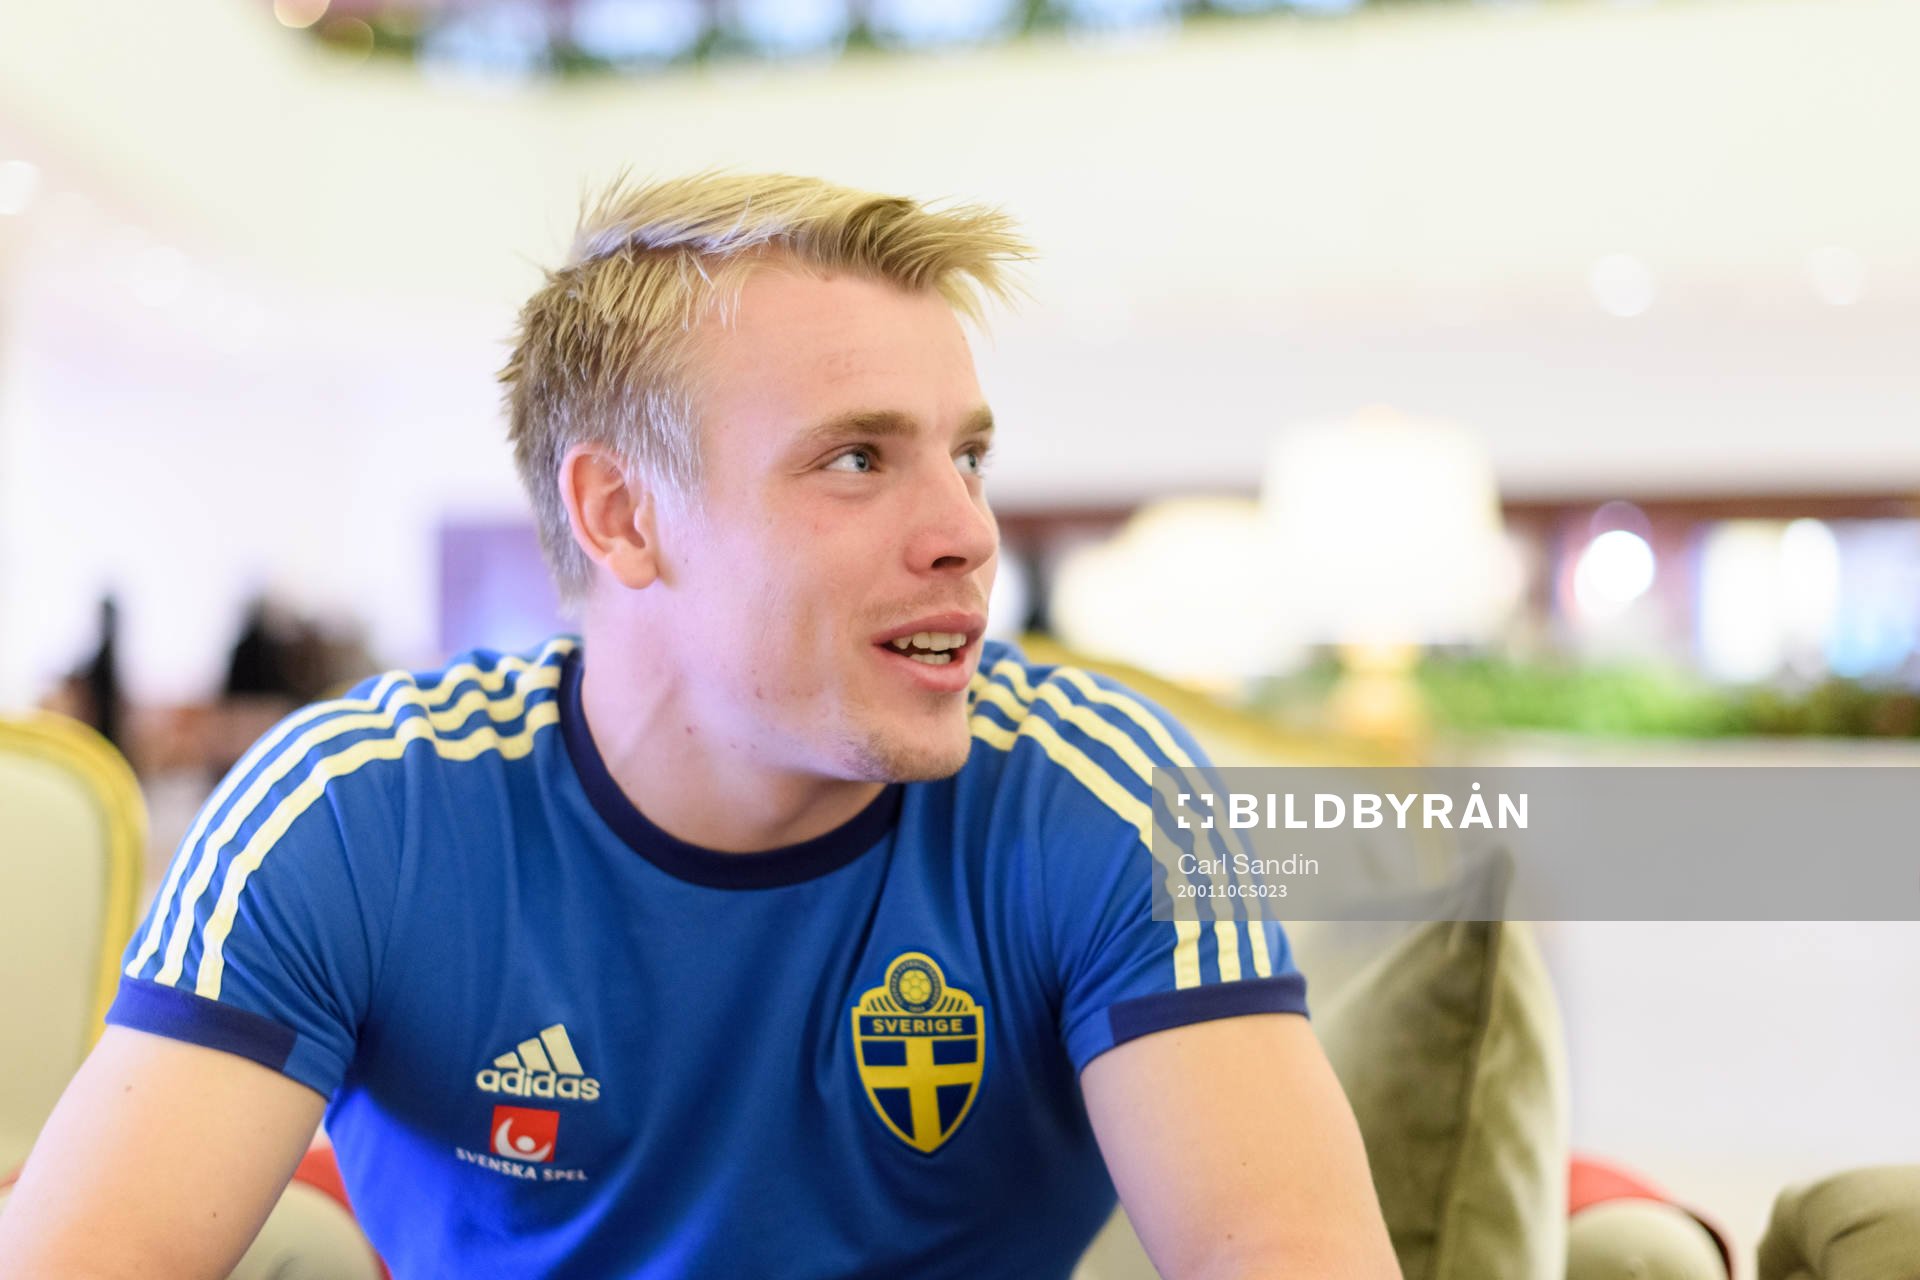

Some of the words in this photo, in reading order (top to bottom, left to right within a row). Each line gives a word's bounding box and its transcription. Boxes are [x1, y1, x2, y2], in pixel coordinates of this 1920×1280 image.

[872, 1018, 963, 1033] SVERIGE
[476, 1067, 600, 1101] adidas
[456, 1147, 537, 1181] SVENSKA
[543, 1168, 588, 1182] SPEL
